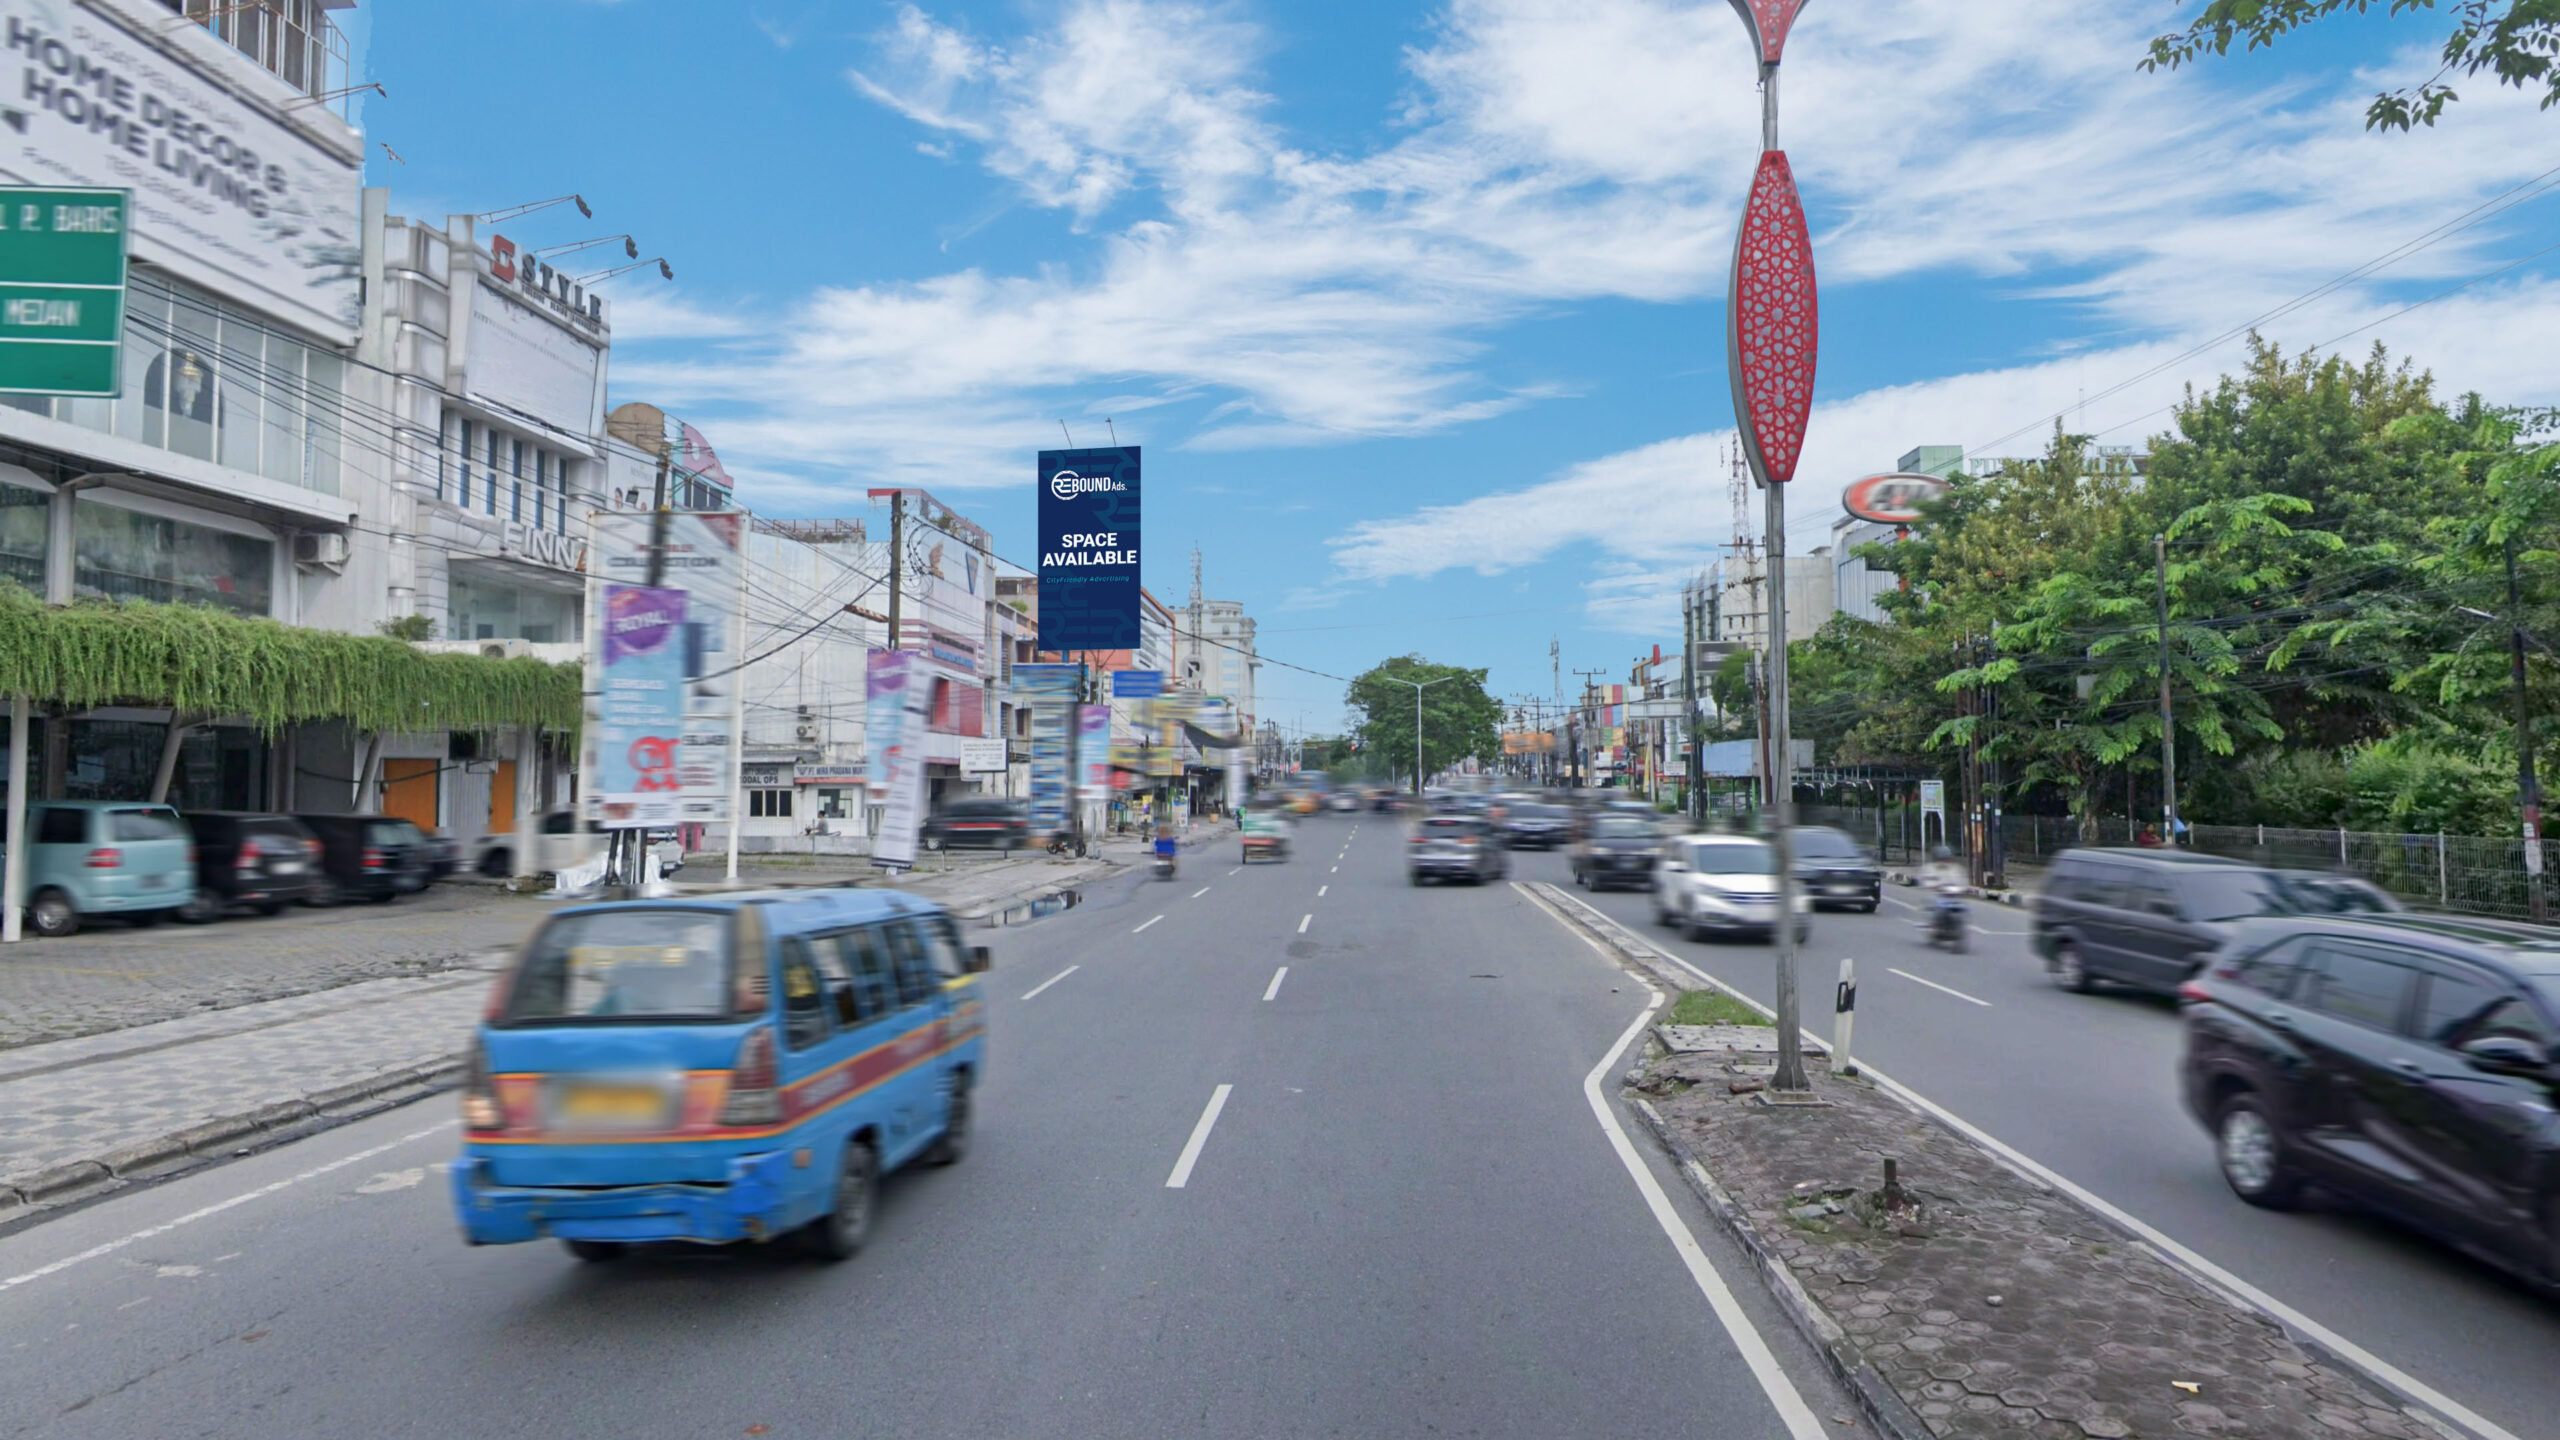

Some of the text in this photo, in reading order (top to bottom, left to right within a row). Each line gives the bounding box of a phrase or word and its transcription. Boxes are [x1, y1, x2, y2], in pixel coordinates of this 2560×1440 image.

[6, 16, 136, 112] HOME
[140, 92, 261, 181] DECOR
[22, 66, 149, 158] HOME
[153, 137, 270, 219] LIVING
[1062, 532, 1118, 548] SPACE
[1042, 549, 1138, 567] AVAILABLE
[740, 775, 762, 784] ODAL
